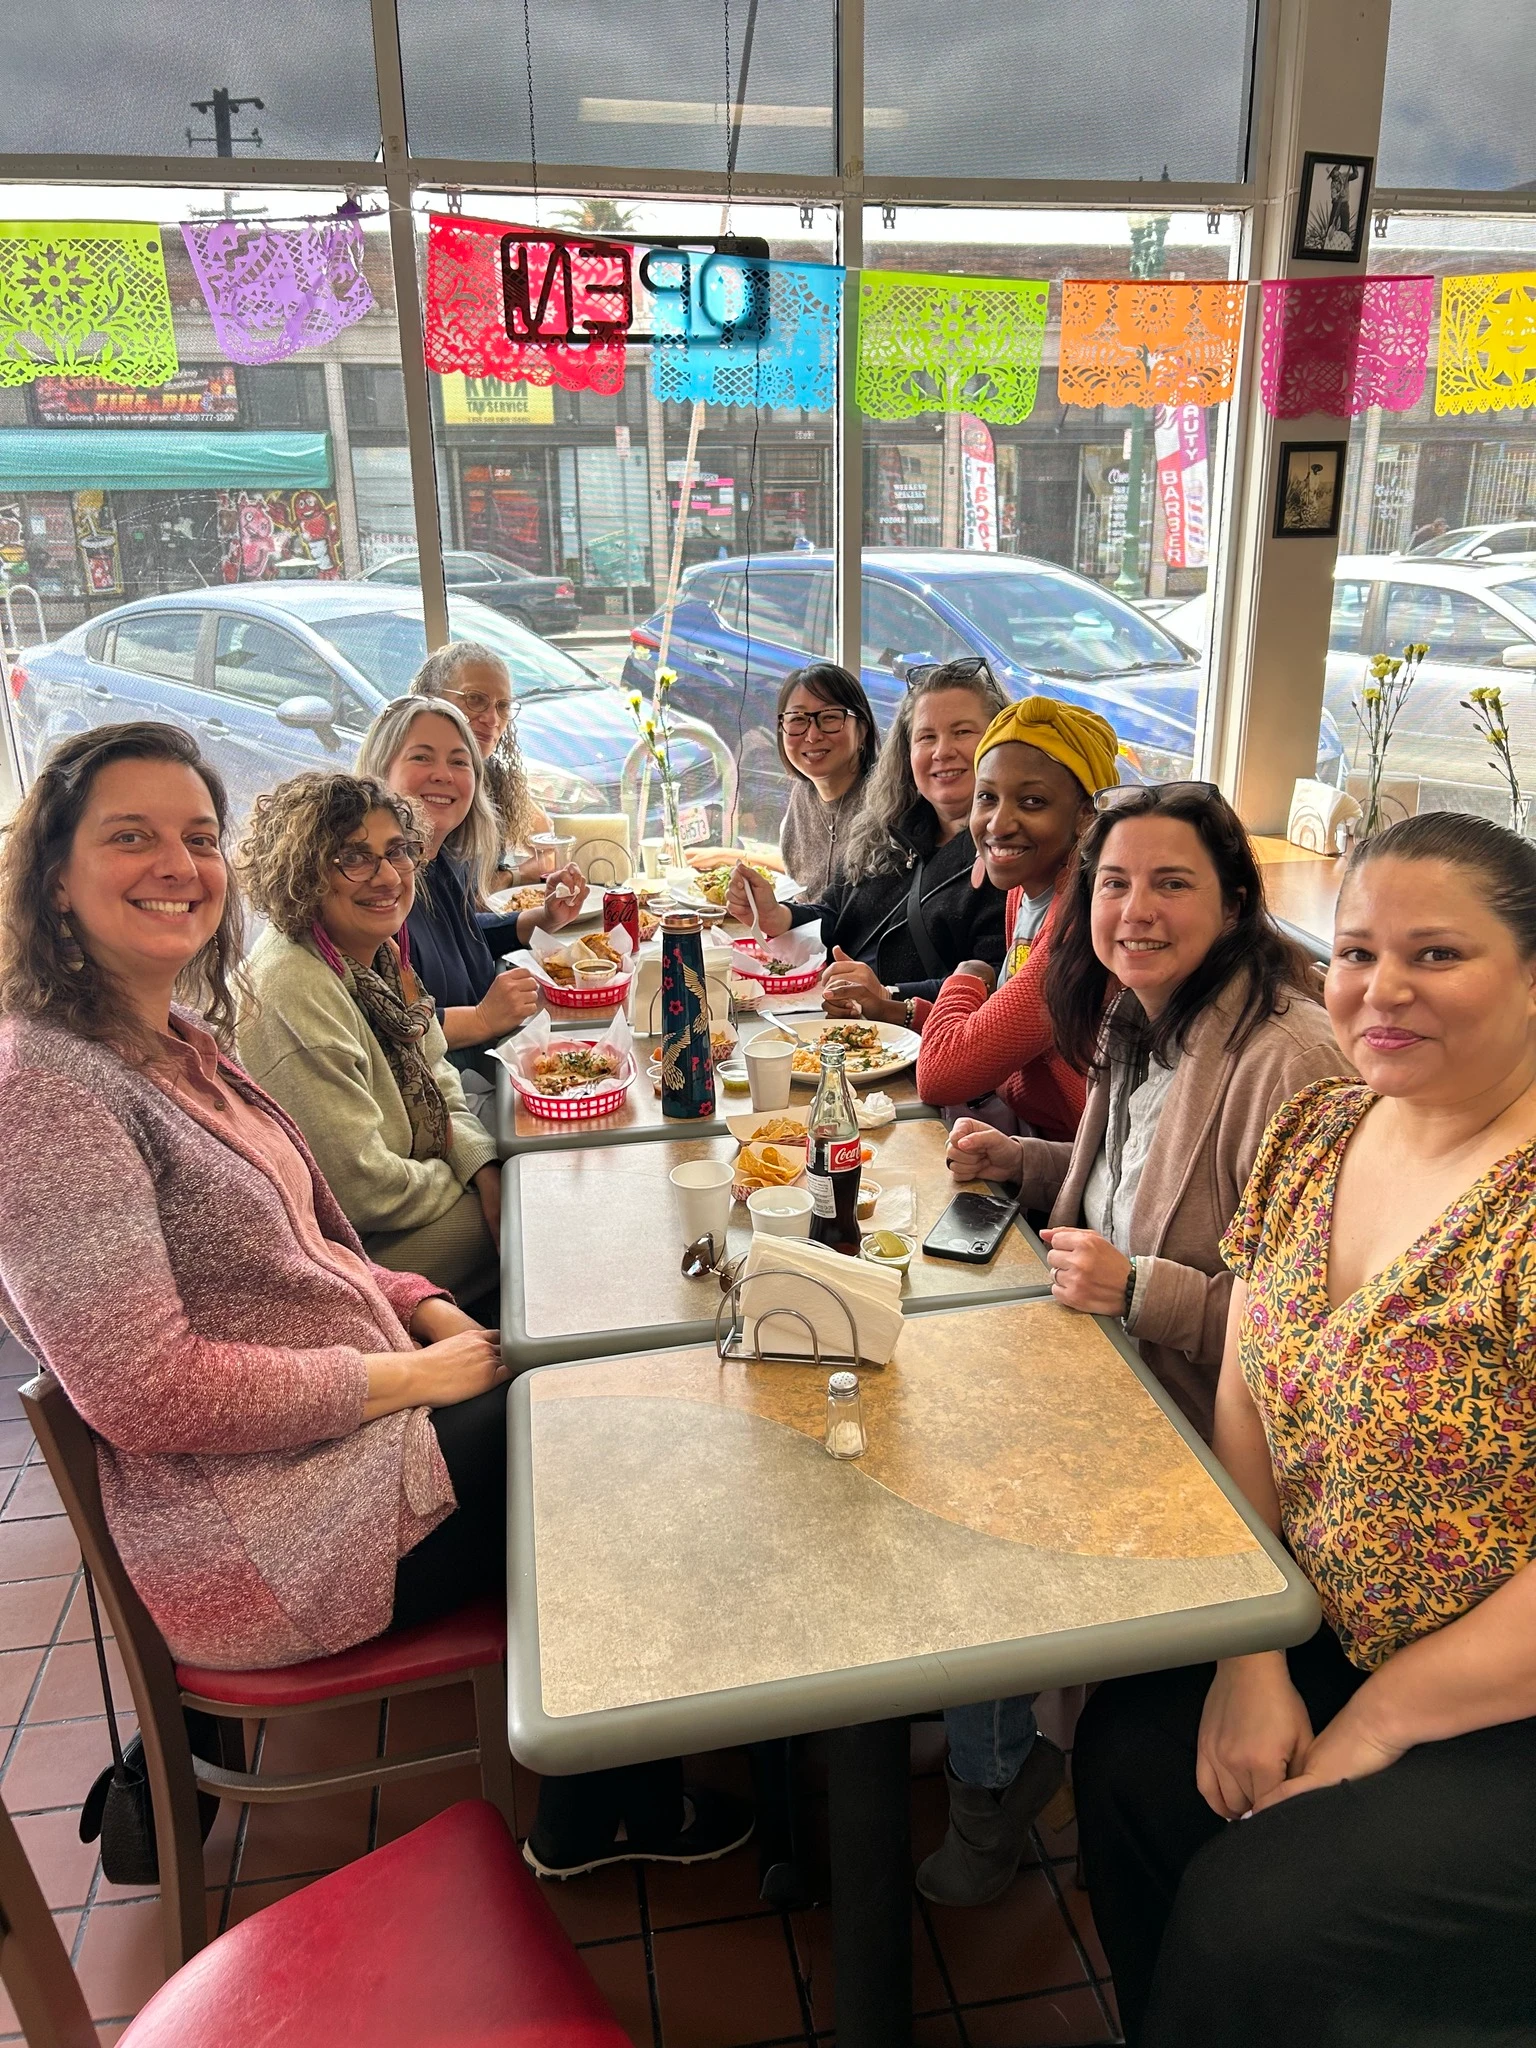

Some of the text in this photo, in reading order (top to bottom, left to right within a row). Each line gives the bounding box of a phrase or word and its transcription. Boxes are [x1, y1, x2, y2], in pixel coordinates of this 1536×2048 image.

[487, 401, 529, 413] SERVICE
[1182, 405, 1200, 461] AUTY
[1161, 470, 1182, 562] BARBER
[679, 818, 708, 841] GH573
